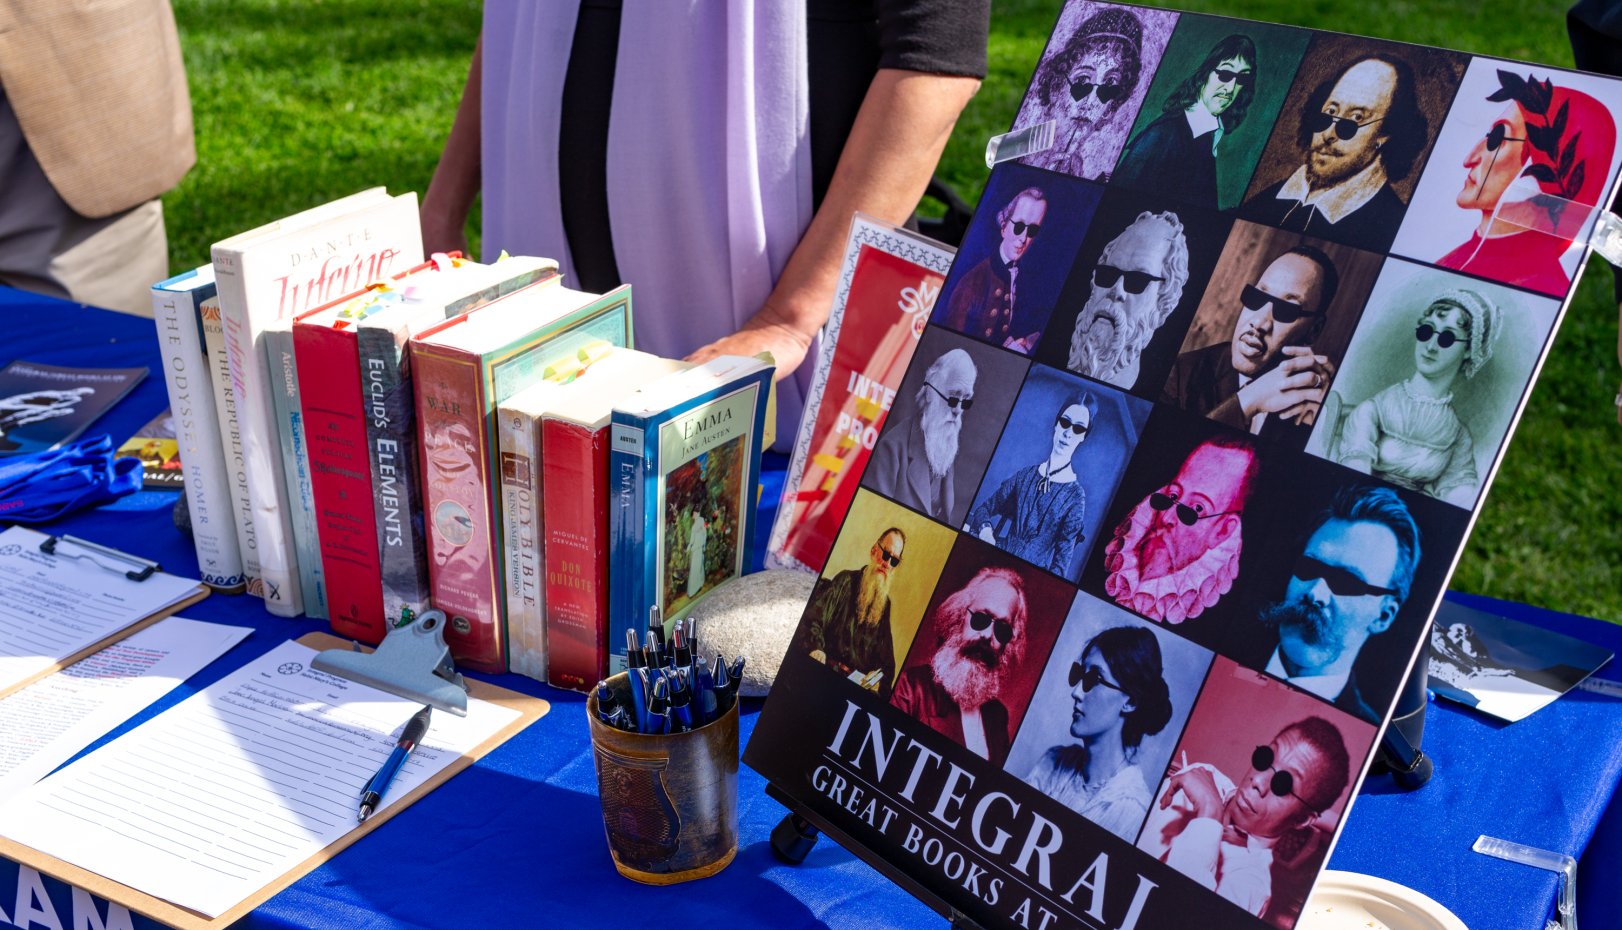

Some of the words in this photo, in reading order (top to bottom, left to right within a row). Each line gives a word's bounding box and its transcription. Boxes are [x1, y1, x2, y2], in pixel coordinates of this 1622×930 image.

[273, 248, 401, 321] Inferno
[164, 301, 181, 345] THE
[282, 351, 296, 397] Aristotle
[368, 358, 391, 428] EUCLID'S
[172, 357, 197, 454] ODYSSEY
[224, 388, 244, 467] REPUBLIC
[427, 396, 461, 416] WAR
[683, 407, 733, 440] EMMA
[620, 435, 637, 444] AUSTEN
[681, 442, 699, 460] JANE
[701, 426, 731, 444] AUSTEN
[835, 411, 879, 451] PRO
[192, 466, 208, 524] HOMER
[237, 471, 248, 493] OF
[377, 438, 402, 546] ELEMENTS
[621, 462, 634, 508] EMMA
[241, 498, 257, 550] PLATO
[509, 492, 517, 518] KING
[504, 455, 531, 529] HOLY
[521, 537, 535, 607] BIBLE
[552, 537, 589, 551] CERVANTES
[553, 530, 578, 540] MIGUEL
[550, 571, 592, 593] QUIXOTE
[562, 560, 580, 575] DON
[812, 764, 899, 836] GREAT
[901, 822, 1004, 906] BOOKS
[1009, 897, 1058, 930] AT
[0, 864, 134, 930] AM
